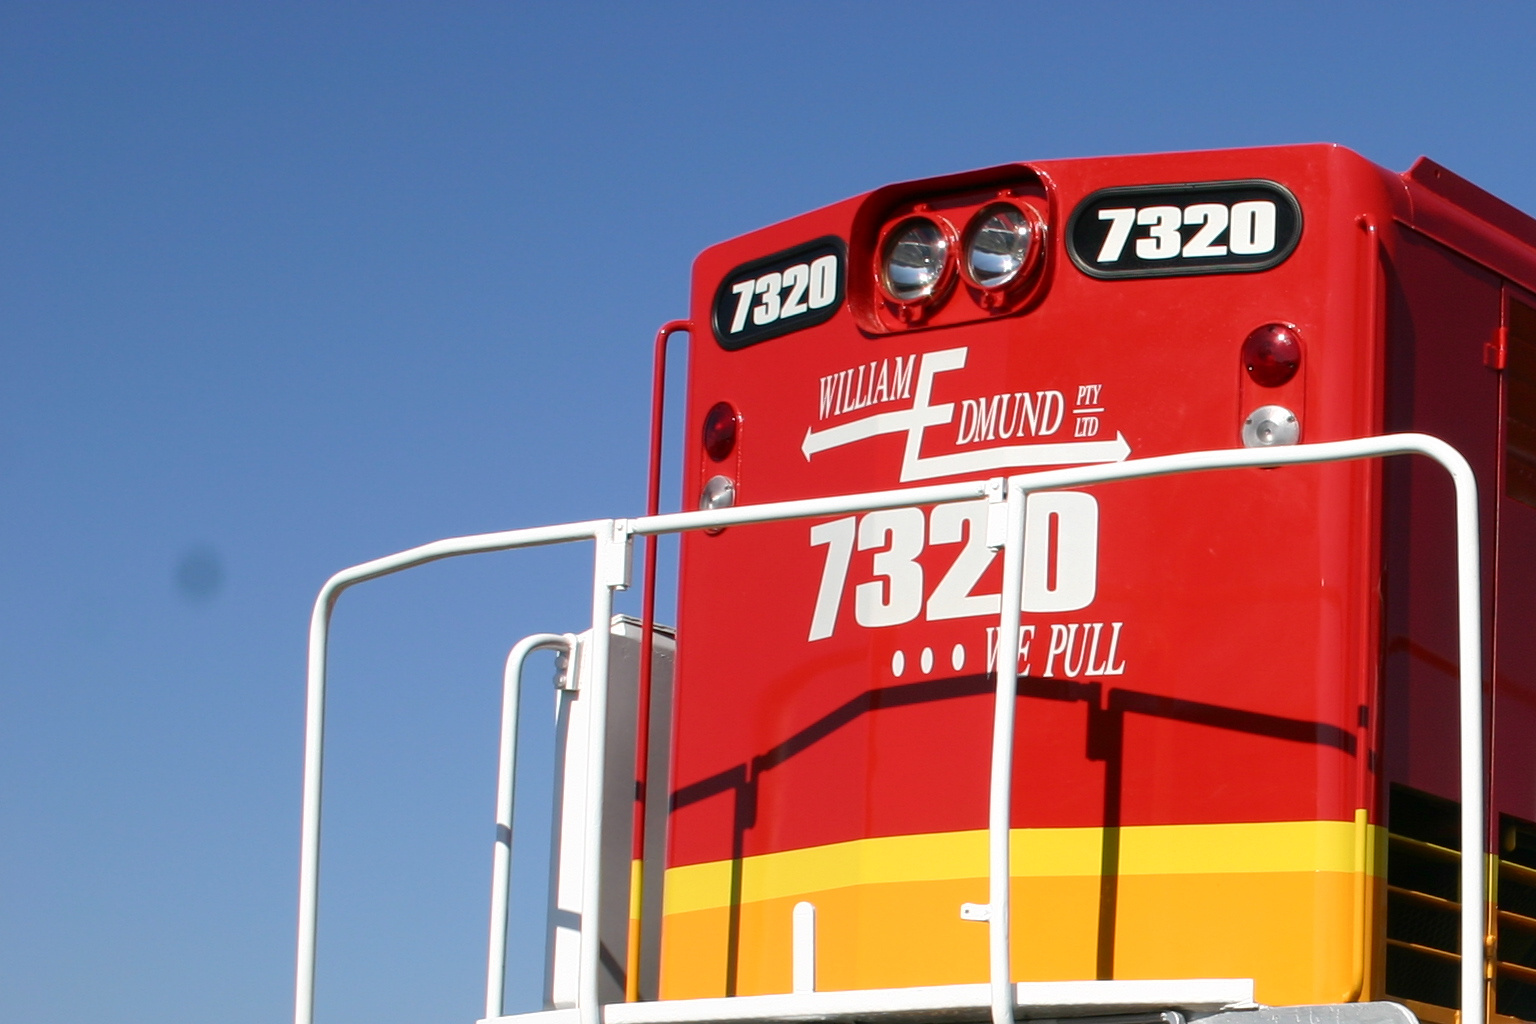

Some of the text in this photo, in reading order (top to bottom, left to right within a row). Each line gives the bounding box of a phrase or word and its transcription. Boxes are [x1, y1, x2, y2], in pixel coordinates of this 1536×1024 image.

[1097, 200, 1277, 264] 7320
[729, 255, 838, 334] 7320
[819, 354, 916, 421] WILLIAM
[1075, 384, 1102, 406] PTY
[1074, 416, 1099, 438] LTD
[807, 491, 1099, 642] 7320
[1043, 622, 1126, 678] PULL
